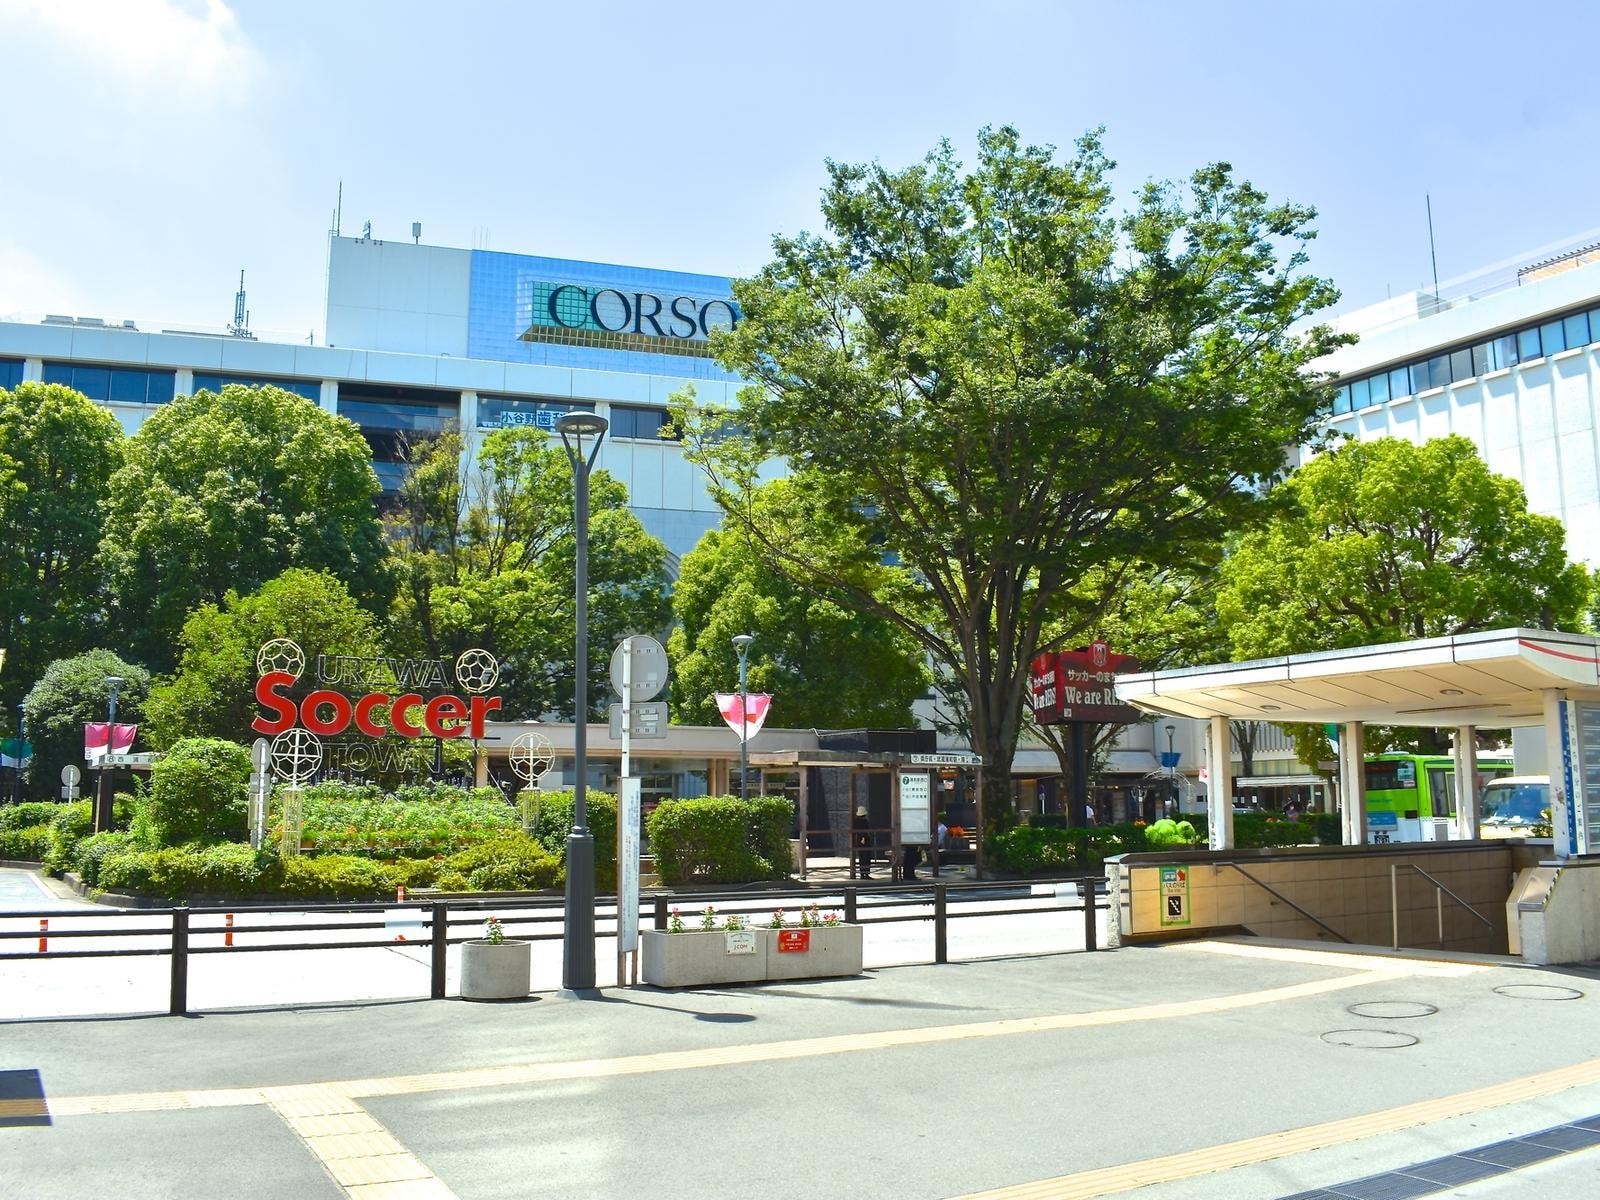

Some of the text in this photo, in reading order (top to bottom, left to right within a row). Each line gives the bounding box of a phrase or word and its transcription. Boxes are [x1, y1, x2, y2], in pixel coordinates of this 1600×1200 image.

[549, 284, 738, 339] CORSO
[318, 654, 449, 688] URAWA
[251, 671, 502, 739] Soccer
[1065, 686, 1082, 704] We
[1084, 690, 1101, 705] are
[322, 743, 440, 773] TOWN
